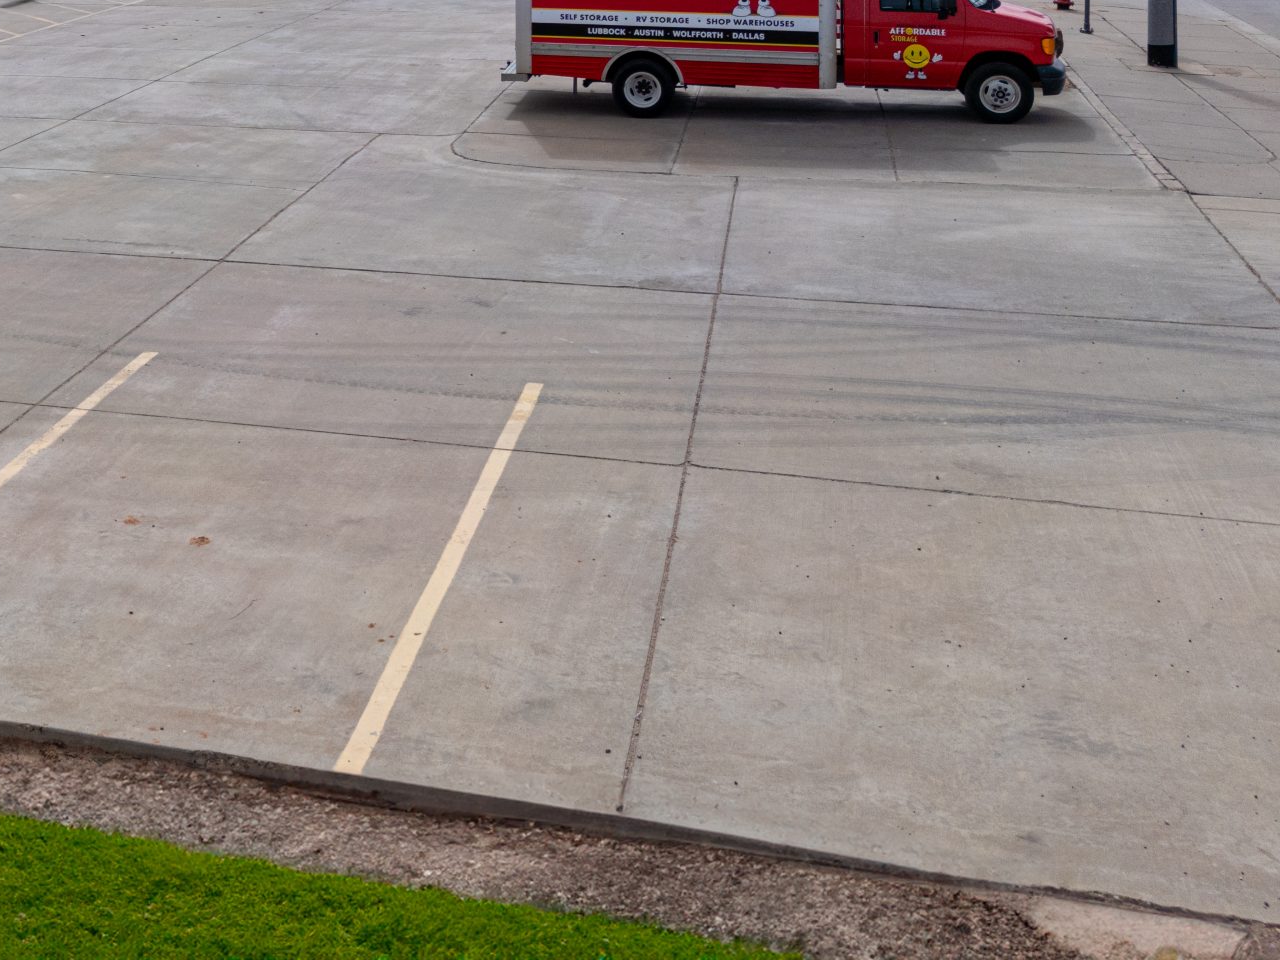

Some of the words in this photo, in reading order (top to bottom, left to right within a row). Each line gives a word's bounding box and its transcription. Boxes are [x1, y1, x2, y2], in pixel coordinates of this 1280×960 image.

[559, 13, 578, 22] SELF
[579, 13, 619, 22] STORAGE
[635, 15, 648, 23] RV
[649, 16, 690, 25] STORAGE
[706, 17, 731, 26] SHOP
[732, 18, 795, 28] WAREHOUSES
[587, 27, 626, 36] LUBBOCK
[633, 28, 664, 37] AUSTIN
[672, 29, 723, 39] WOLFFORTH
[732, 31, 765, 41] DALLAS
[889, 27, 946, 37] AFFORDABLE
[890, 35, 918, 43] STORAGE
